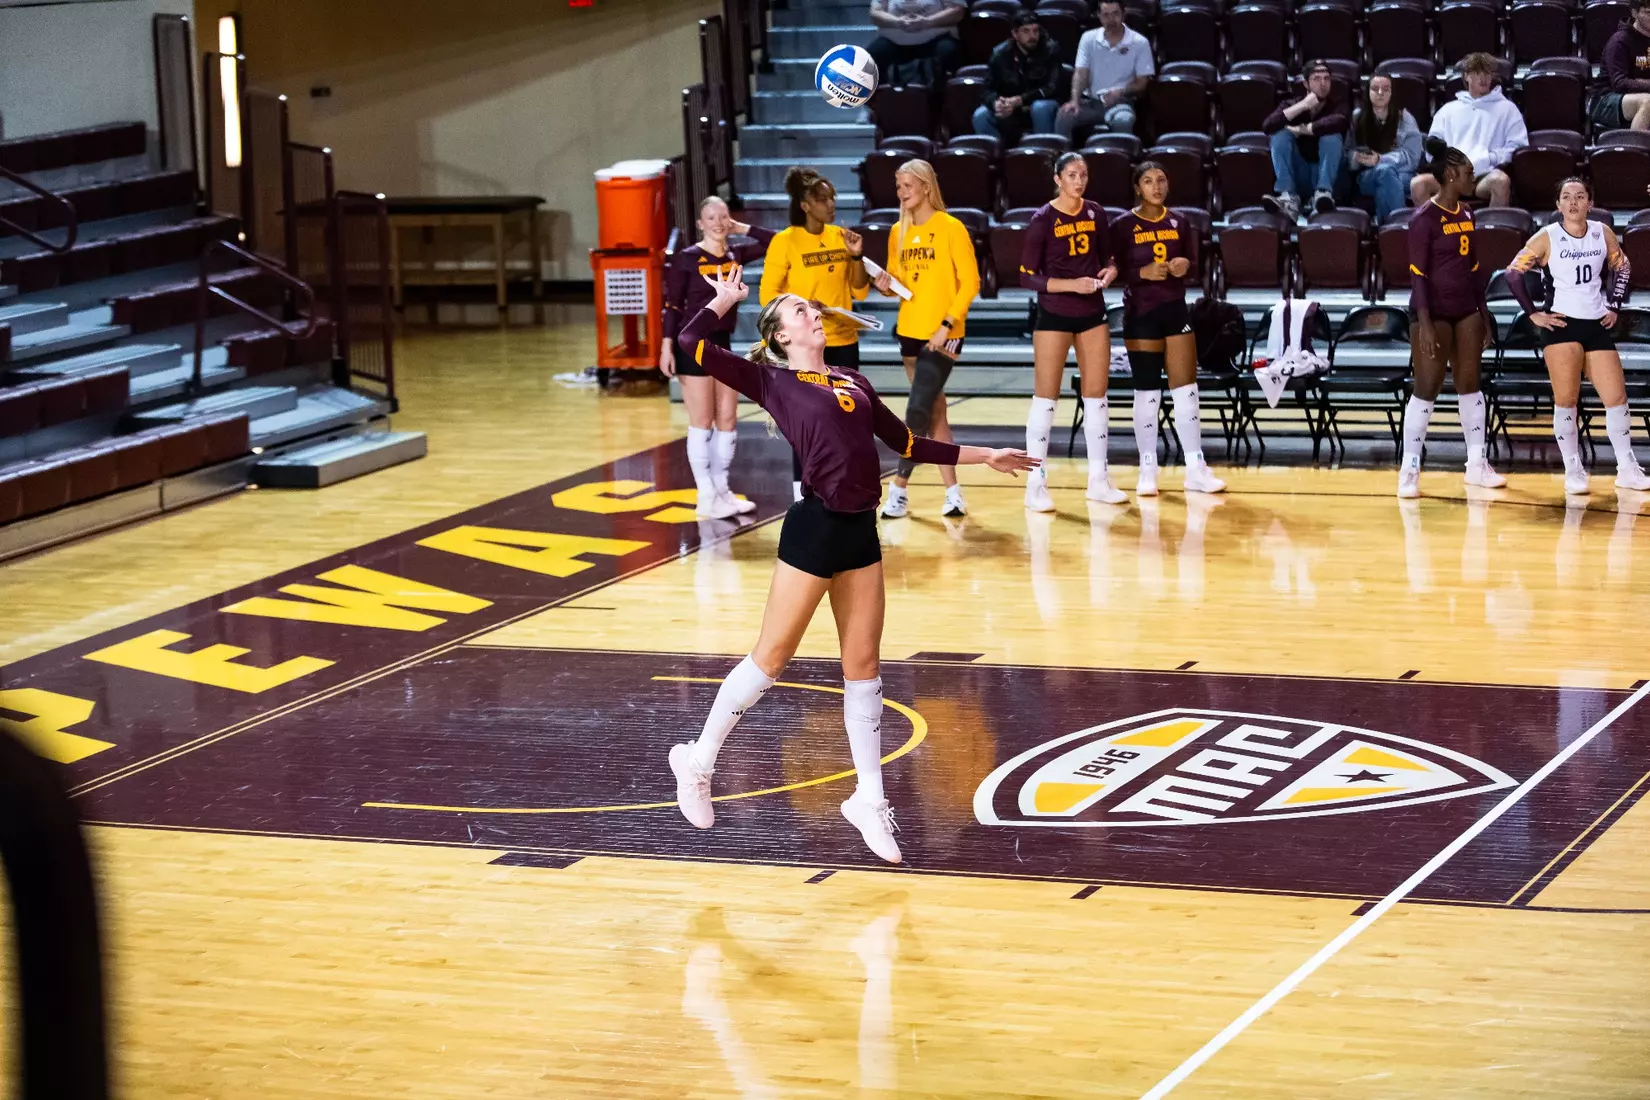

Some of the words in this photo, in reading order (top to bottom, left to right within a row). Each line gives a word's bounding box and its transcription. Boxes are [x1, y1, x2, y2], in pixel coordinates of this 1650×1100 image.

[827, 84, 860, 104] molten
[928, 232, 936, 244] 7
[1068, 233, 1090, 256] 13
[1459, 234, 1470, 256] 8
[1152, 242, 1167, 264] 9
[1575, 264, 1593, 286] 10
[796, 373, 831, 387] CENTRAL
[833, 388, 857, 413] 6
[1072, 748, 1141, 779] 1946
[1108, 723, 1312, 821] MAC
